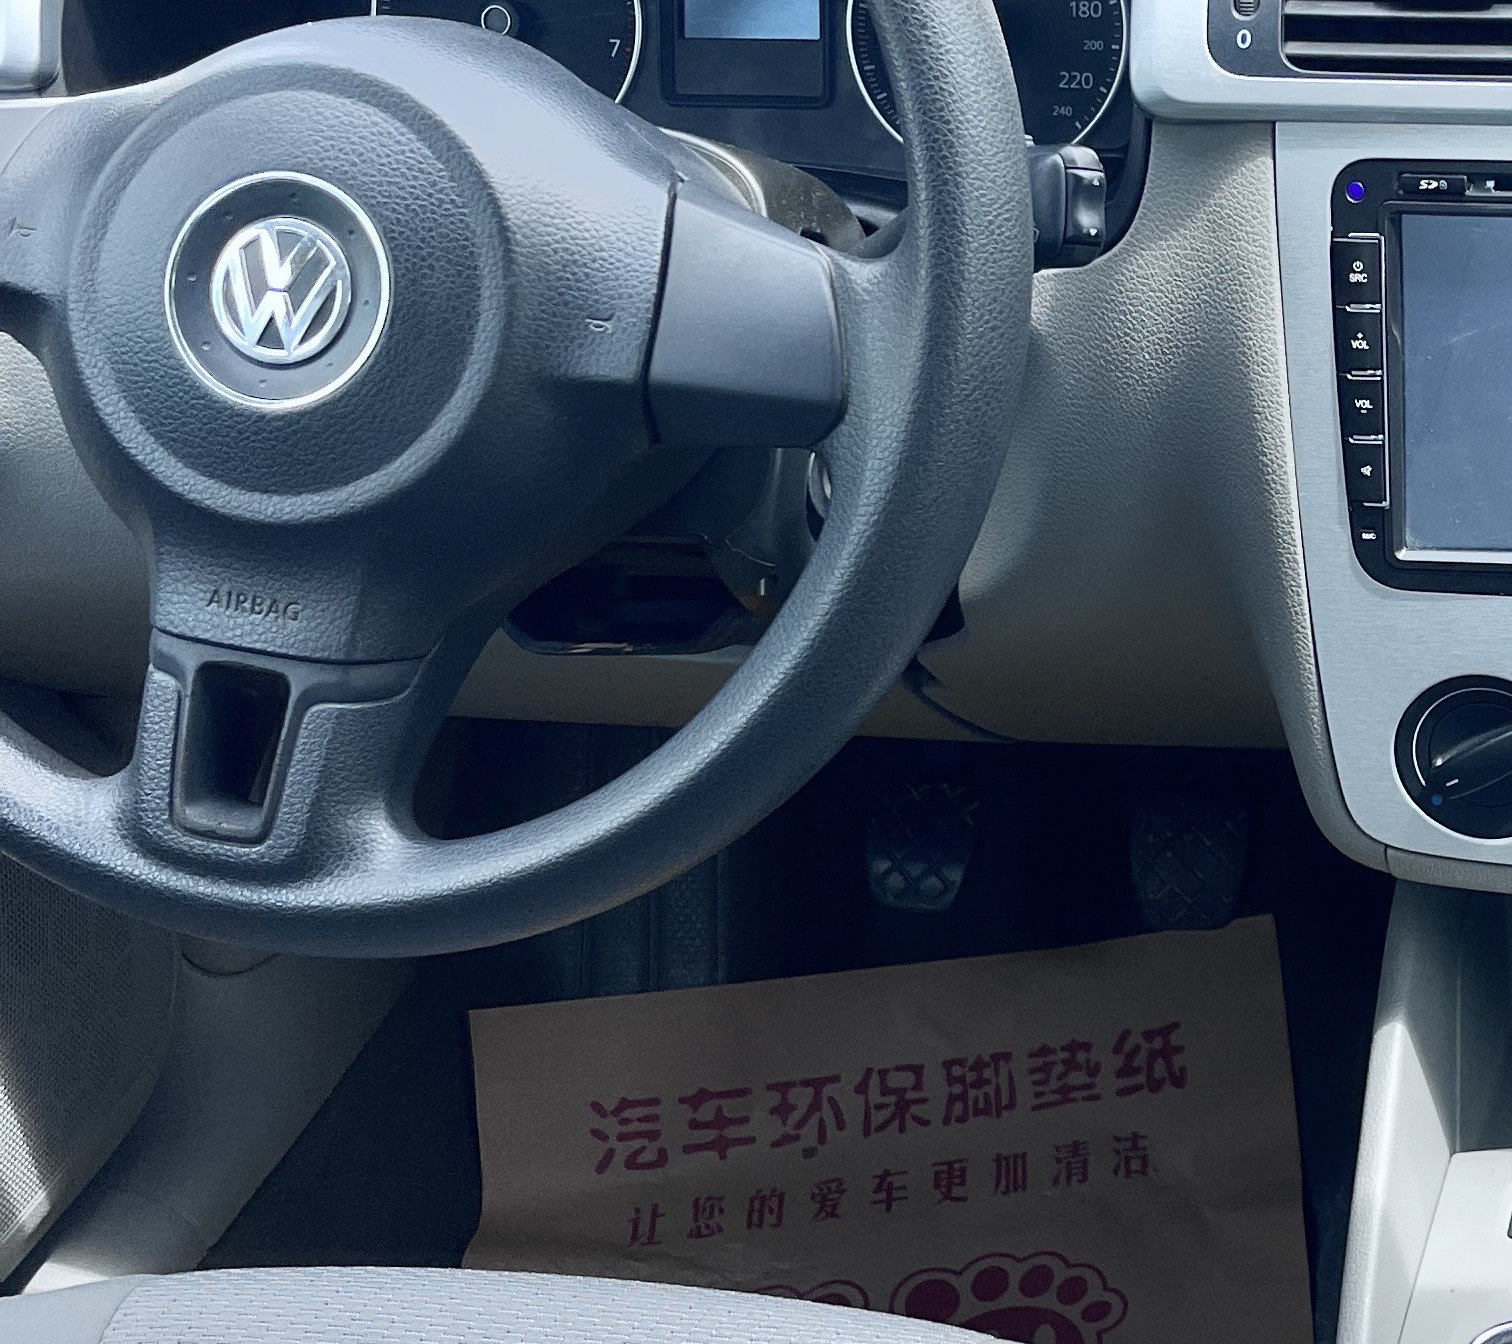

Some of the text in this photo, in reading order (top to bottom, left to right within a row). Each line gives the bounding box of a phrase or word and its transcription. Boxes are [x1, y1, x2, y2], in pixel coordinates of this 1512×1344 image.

[1069, 1, 1102, 18] 180
[1083, 40, 1104, 51] 200
[1236, 29, 1252, 49] 0
[609, 39, 620, 57] 7
[1058, 72, 1094, 89] 220
[1052, 105, 1073, 117] 240
[1349, 273, 1368, 283] SRC
[205, 588, 301, 622] AIRBAG
[589, 1021, 1190, 1175] 汽车环保脚垫纸
[626, 1132, 1156, 1247] 让您的爱车更加清洁
